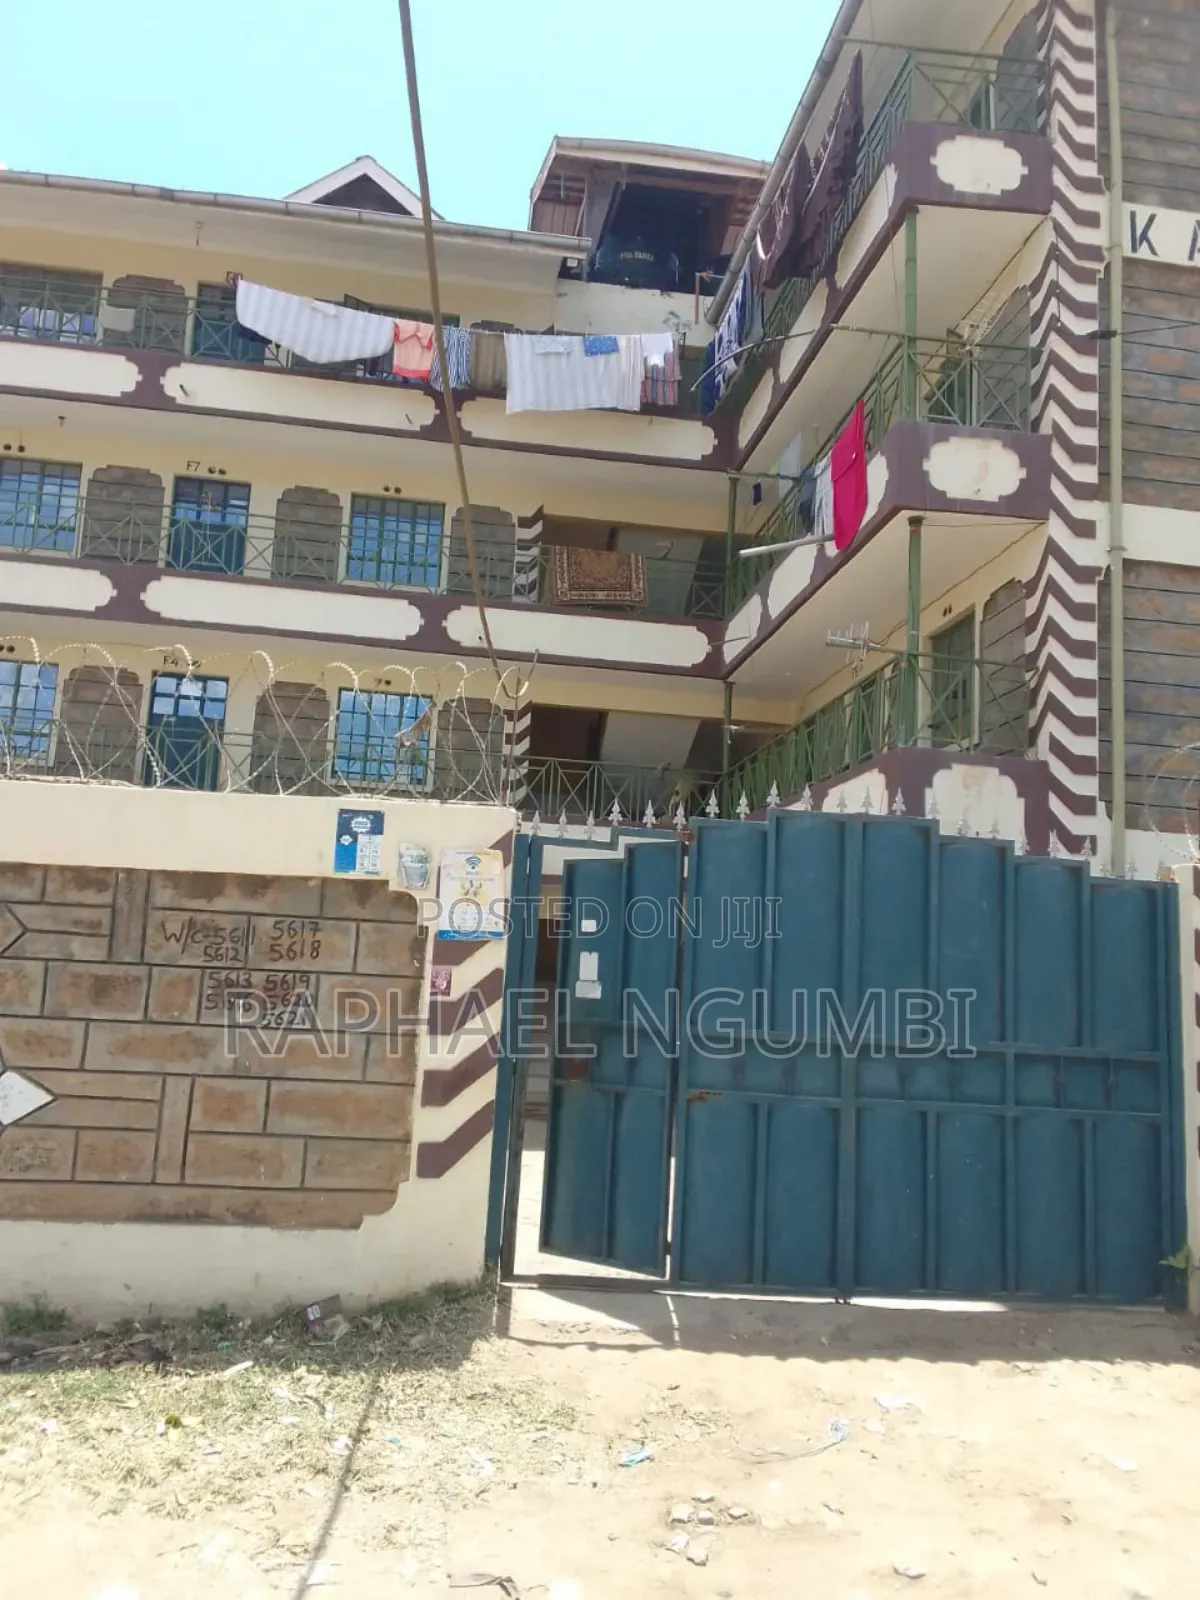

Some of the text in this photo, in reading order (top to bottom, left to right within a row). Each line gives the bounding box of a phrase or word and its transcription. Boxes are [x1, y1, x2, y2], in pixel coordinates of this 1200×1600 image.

[269, 920, 323, 941] 5617
[202, 939, 321, 962] 5612 5618
[208, 970, 310, 992] 5613 5619
